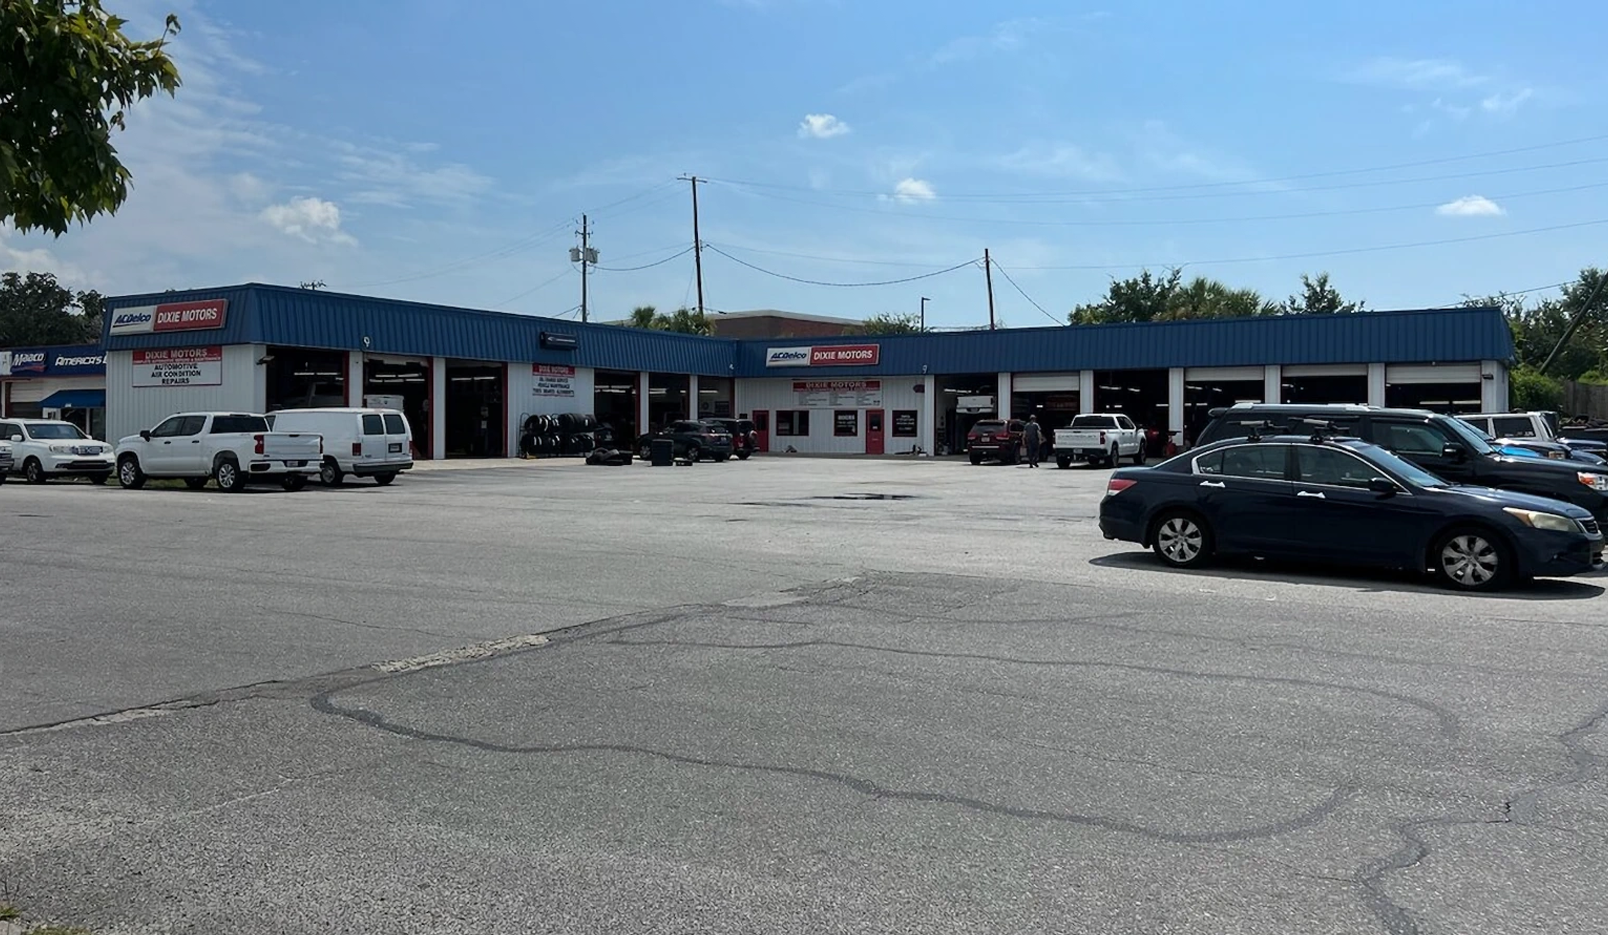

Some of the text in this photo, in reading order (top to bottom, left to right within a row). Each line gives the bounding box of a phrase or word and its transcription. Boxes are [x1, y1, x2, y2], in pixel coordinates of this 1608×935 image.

[114, 314, 151, 325] ACDelco
[157, 308, 217, 323] DIXIE MOTORS
[145, 349, 207, 359] DIXIE MOTORS
[771, 351, 807, 360] ACDelco
[814, 349, 873, 361] DIXIE MOTORS
[163, 370, 201, 378] CONDITION
